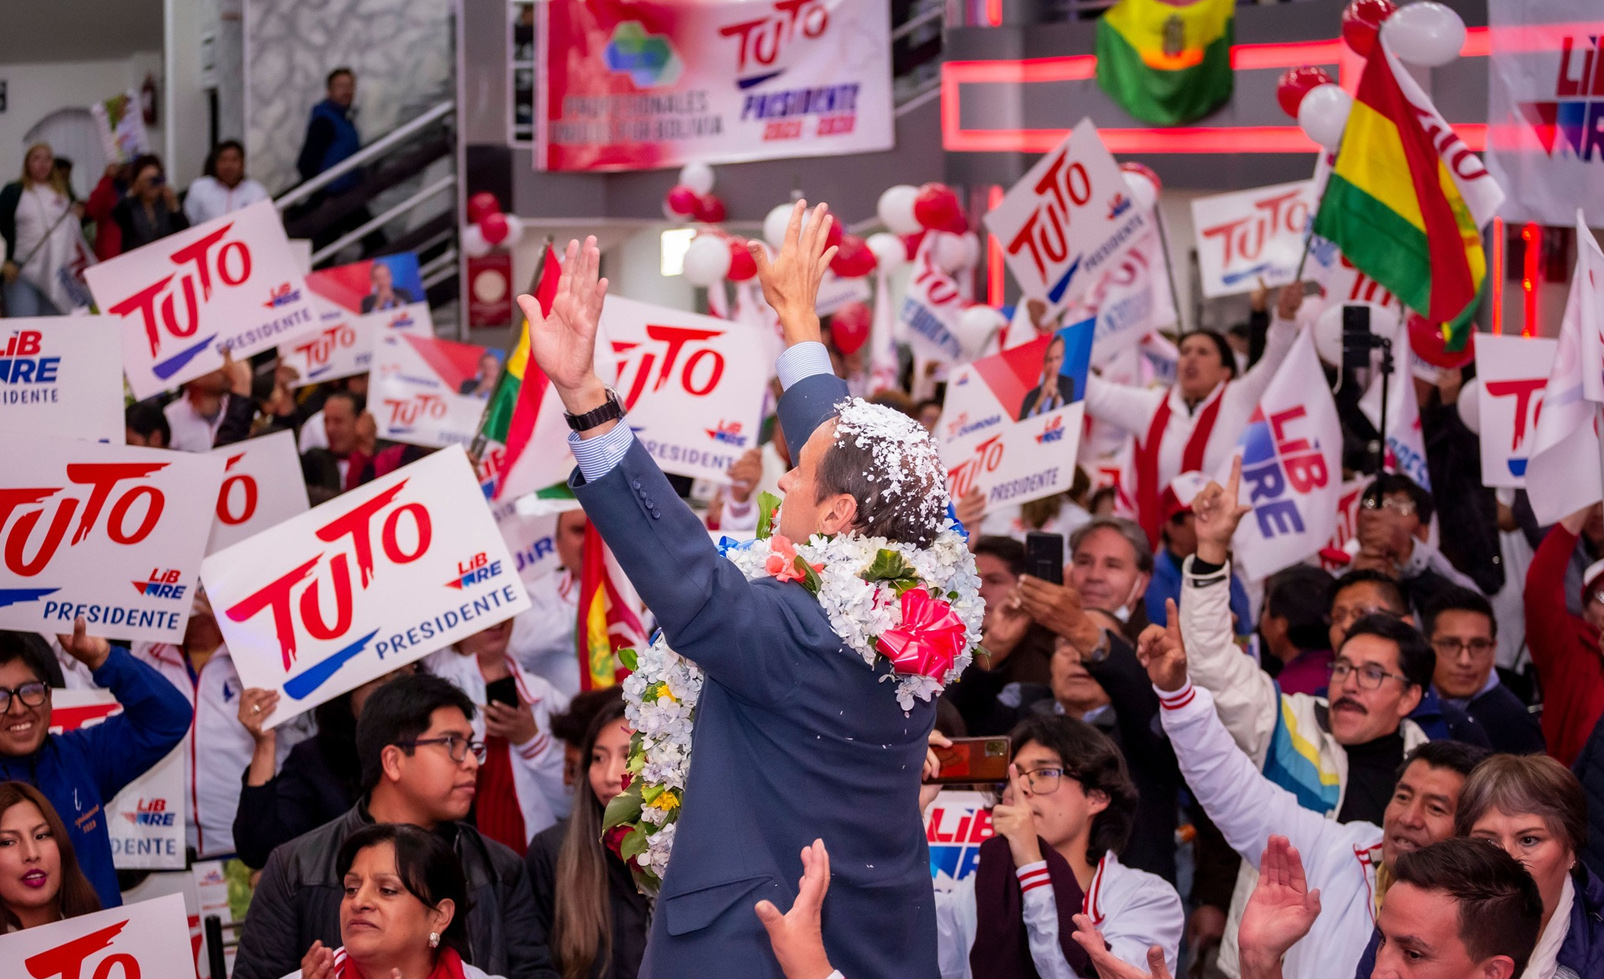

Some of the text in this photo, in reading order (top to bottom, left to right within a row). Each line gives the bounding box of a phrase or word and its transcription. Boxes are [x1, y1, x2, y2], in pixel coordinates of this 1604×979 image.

[719, 0, 828, 72] TUTO
[1557, 37, 1604, 96] Li
[1007, 146, 1091, 286] TUTO
[1203, 190, 1308, 268] TUTO
[108, 220, 252, 359] TUTO
[215, 308, 312, 354] PRESIDENTE
[296, 323, 356, 369] TUTO
[3, 389, 58, 405] IDENTE
[384, 394, 447, 425] TUTO
[644, 441, 733, 471] RESIDENT
[990, 467, 1059, 502] PRESIDENTE
[225, 477, 432, 673] TUTO
[43, 601, 180, 630] PRESIDENTE
[375, 584, 517, 660] PRESIDENTE
[111, 837, 176, 855] DENTE
